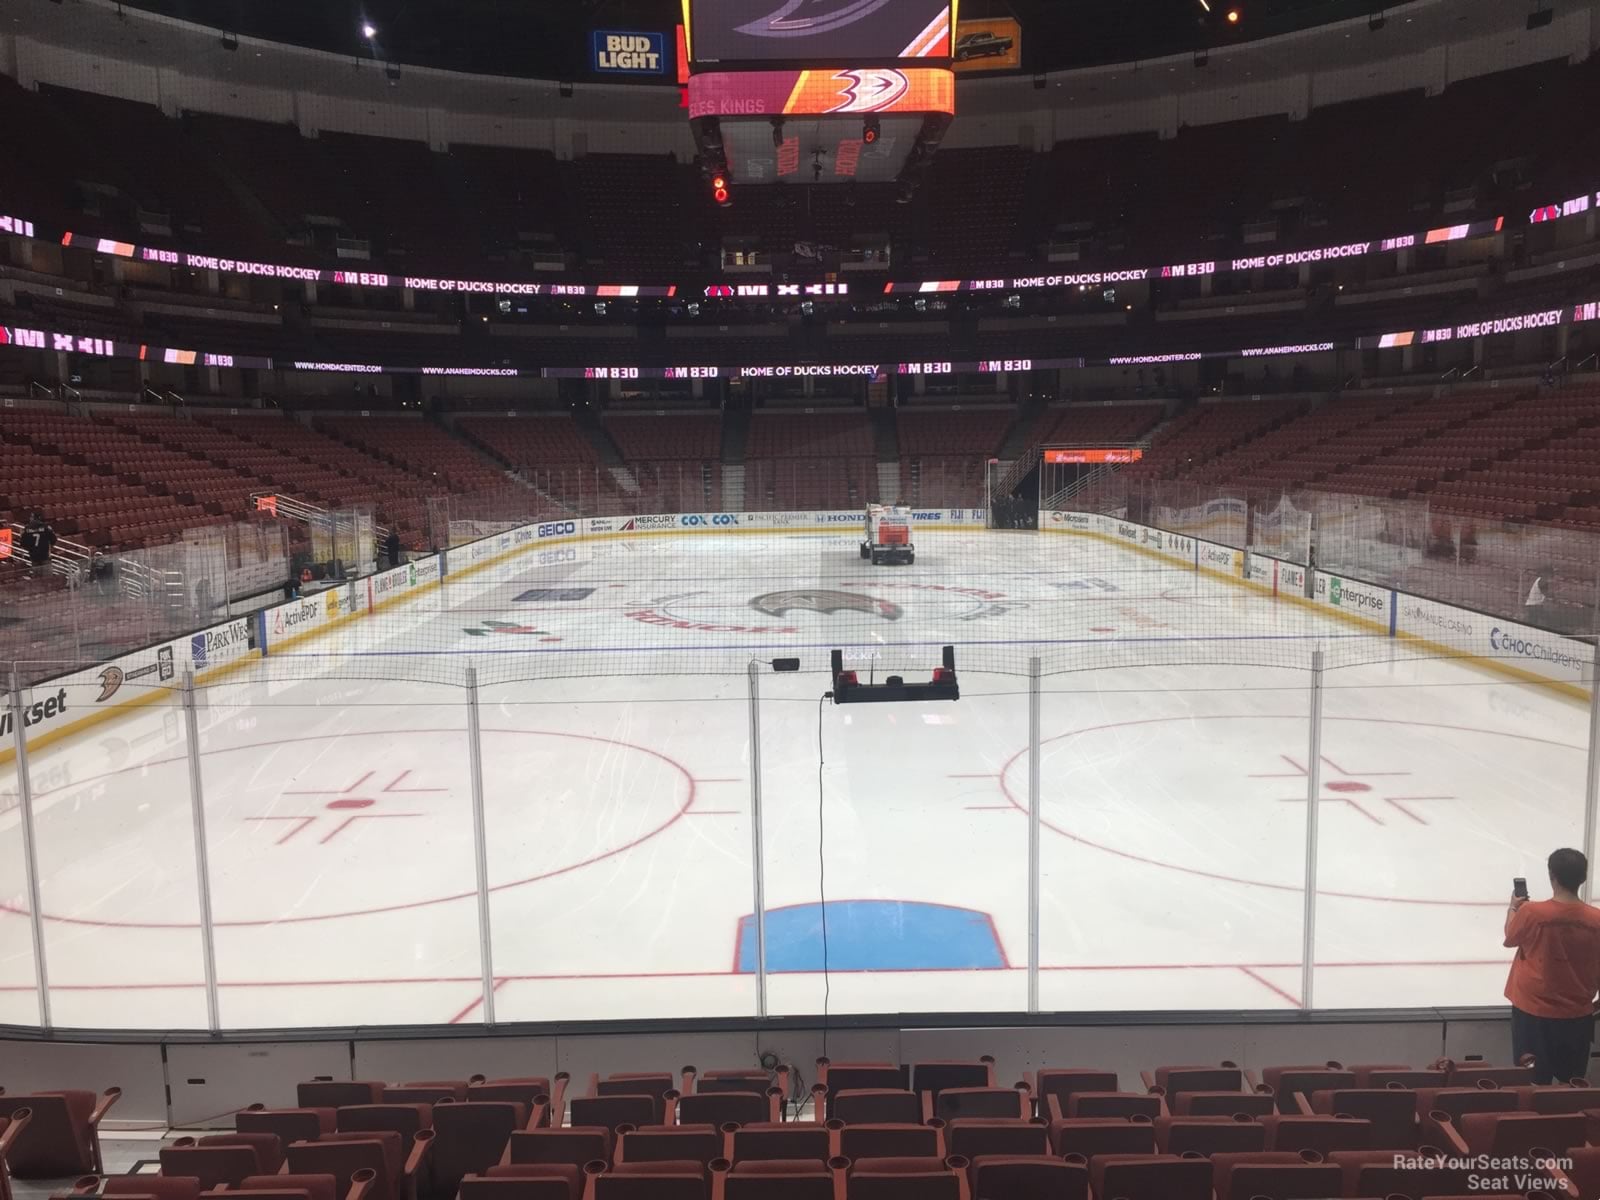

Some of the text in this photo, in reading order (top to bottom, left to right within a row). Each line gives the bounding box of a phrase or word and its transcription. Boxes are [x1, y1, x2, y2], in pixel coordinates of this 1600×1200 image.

[606, 36, 651, 53] BUD
[600, 51, 659, 70] LIGHT
[721, 99, 765, 114] KINGS
[1396, 235, 1414, 248] 830
[159, 251, 178, 263] 830
[1232, 243, 1370, 270] HOME OF DUCKS HOCKEY
[187, 255, 320, 280] HOME OF DUCKS HOCKEY
[1188, 262, 1214, 275] 830
[360, 273, 388, 286] 830
[986, 280, 1004, 288] 830
[1014, 269, 1147, 288] HOME OF DUCKS HOCKEY
[405, 278, 540, 294] HOME OF DUCKS HOCKEY
[567, 286, 585, 294] 830
[1457, 310, 1562, 338] HOME OF DUCKS HOCKEY
[1436, 328, 1451, 340] 830
[217, 355, 233, 366] 830
[1004, 360, 1031, 371] 830
[611, 368, 638, 378] 830
[691, 367, 718, 377] 830
[741, 365, 879, 377] HOME OF DUCKS HOCKEY
[924, 363, 951, 373] 830
[635, 515, 676, 524] MERCURY
[681, 515, 708, 526] COX
[712, 514, 739, 525] COX
[912, 512, 941, 520] TIRES
[538, 521, 575, 537] GEICO
[33, 534, 40, 546] 7
[1334, 581, 1384, 610] enterprise
[285, 602, 318, 628] ActivePDF
[206, 622, 249, 652] PARK WES
[1502, 637, 1532, 656] CHOC
